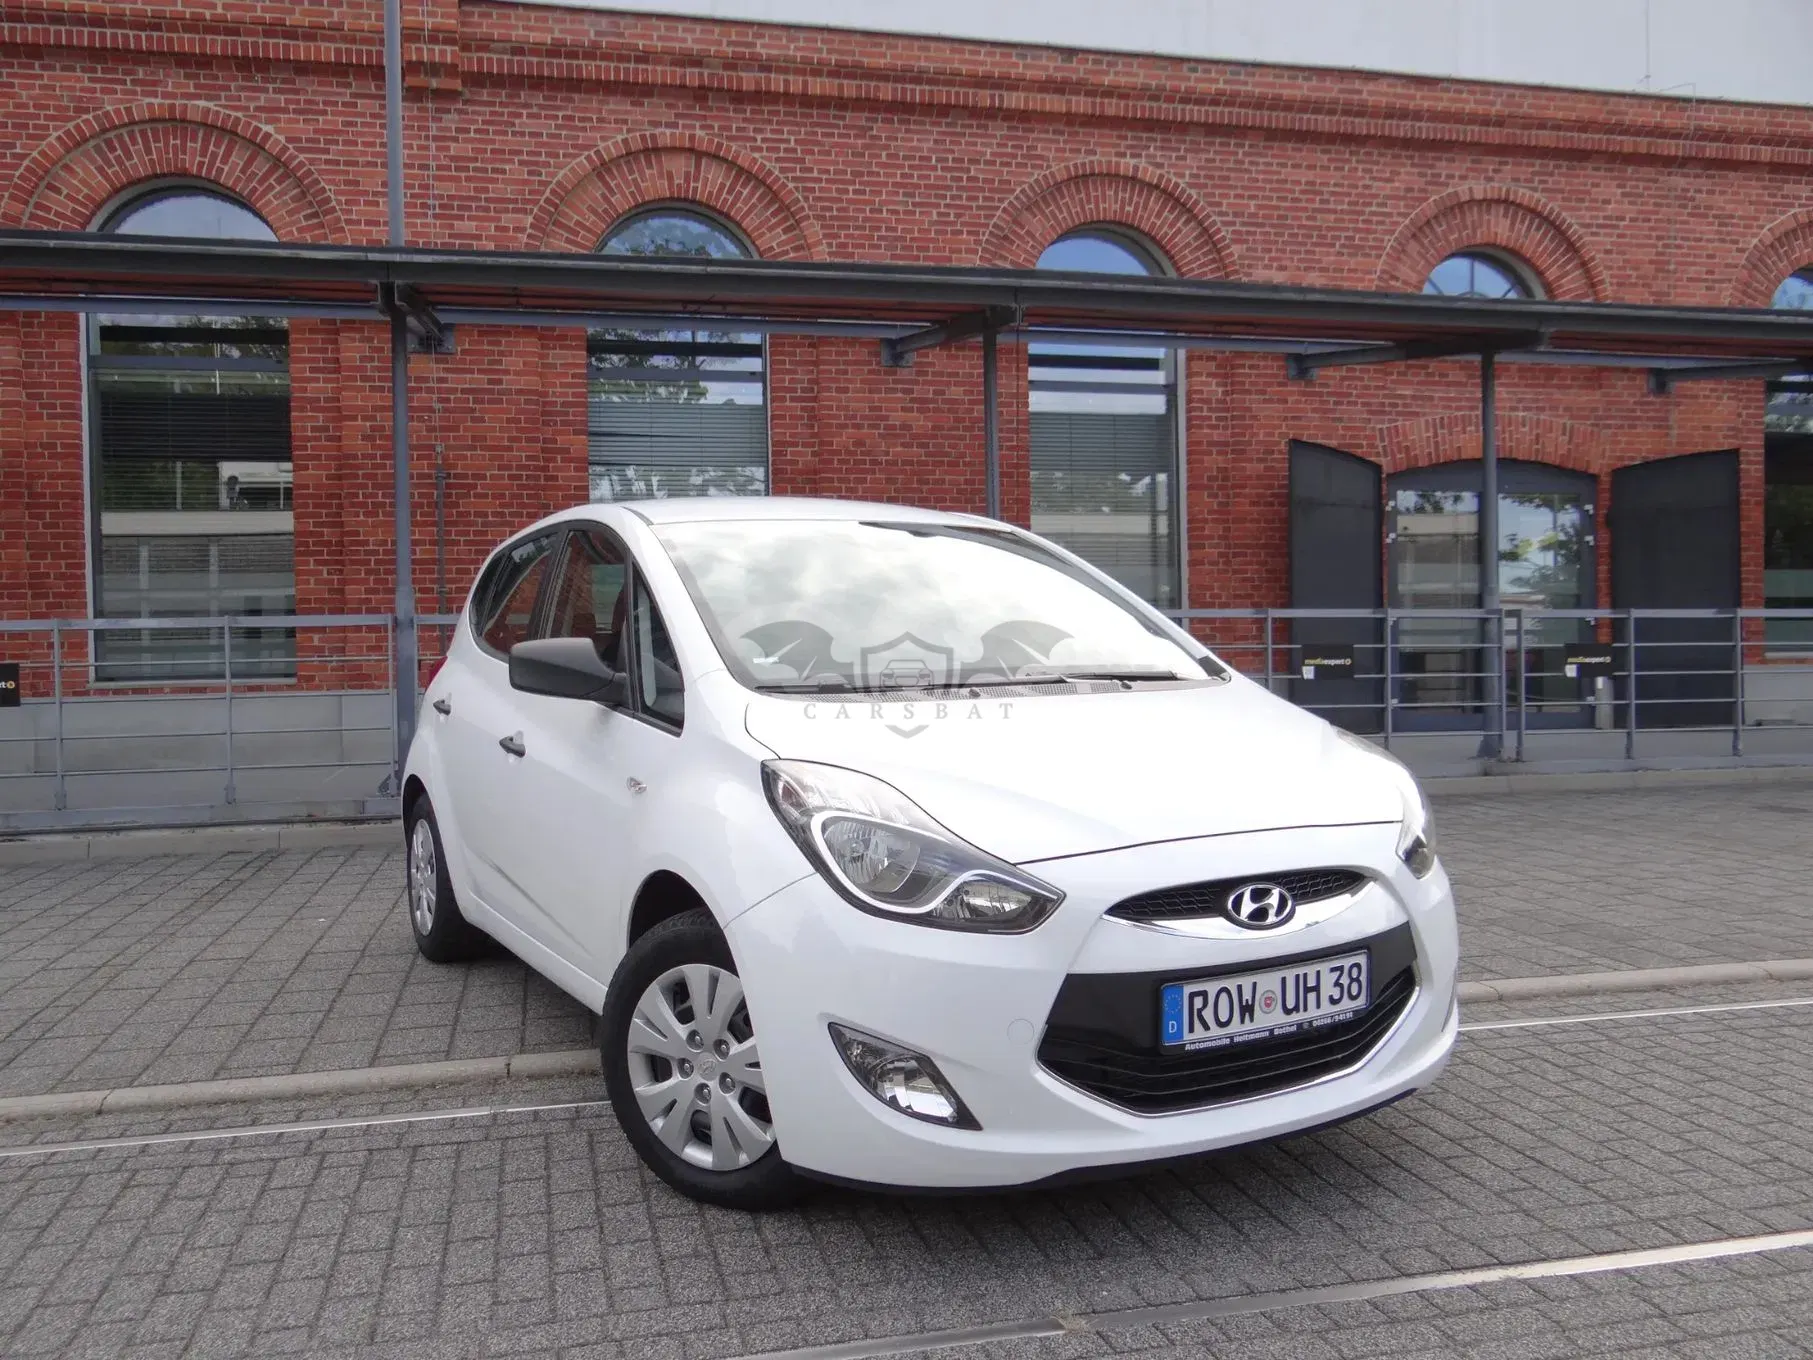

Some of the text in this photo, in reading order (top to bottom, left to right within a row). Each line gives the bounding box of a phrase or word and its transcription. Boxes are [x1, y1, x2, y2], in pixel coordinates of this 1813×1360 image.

[1187, 961, 1363, 1034] ROW UH 38
[1168, 1020, 1178, 1034] D
[1185, 1037, 1230, 1050] Automobile
